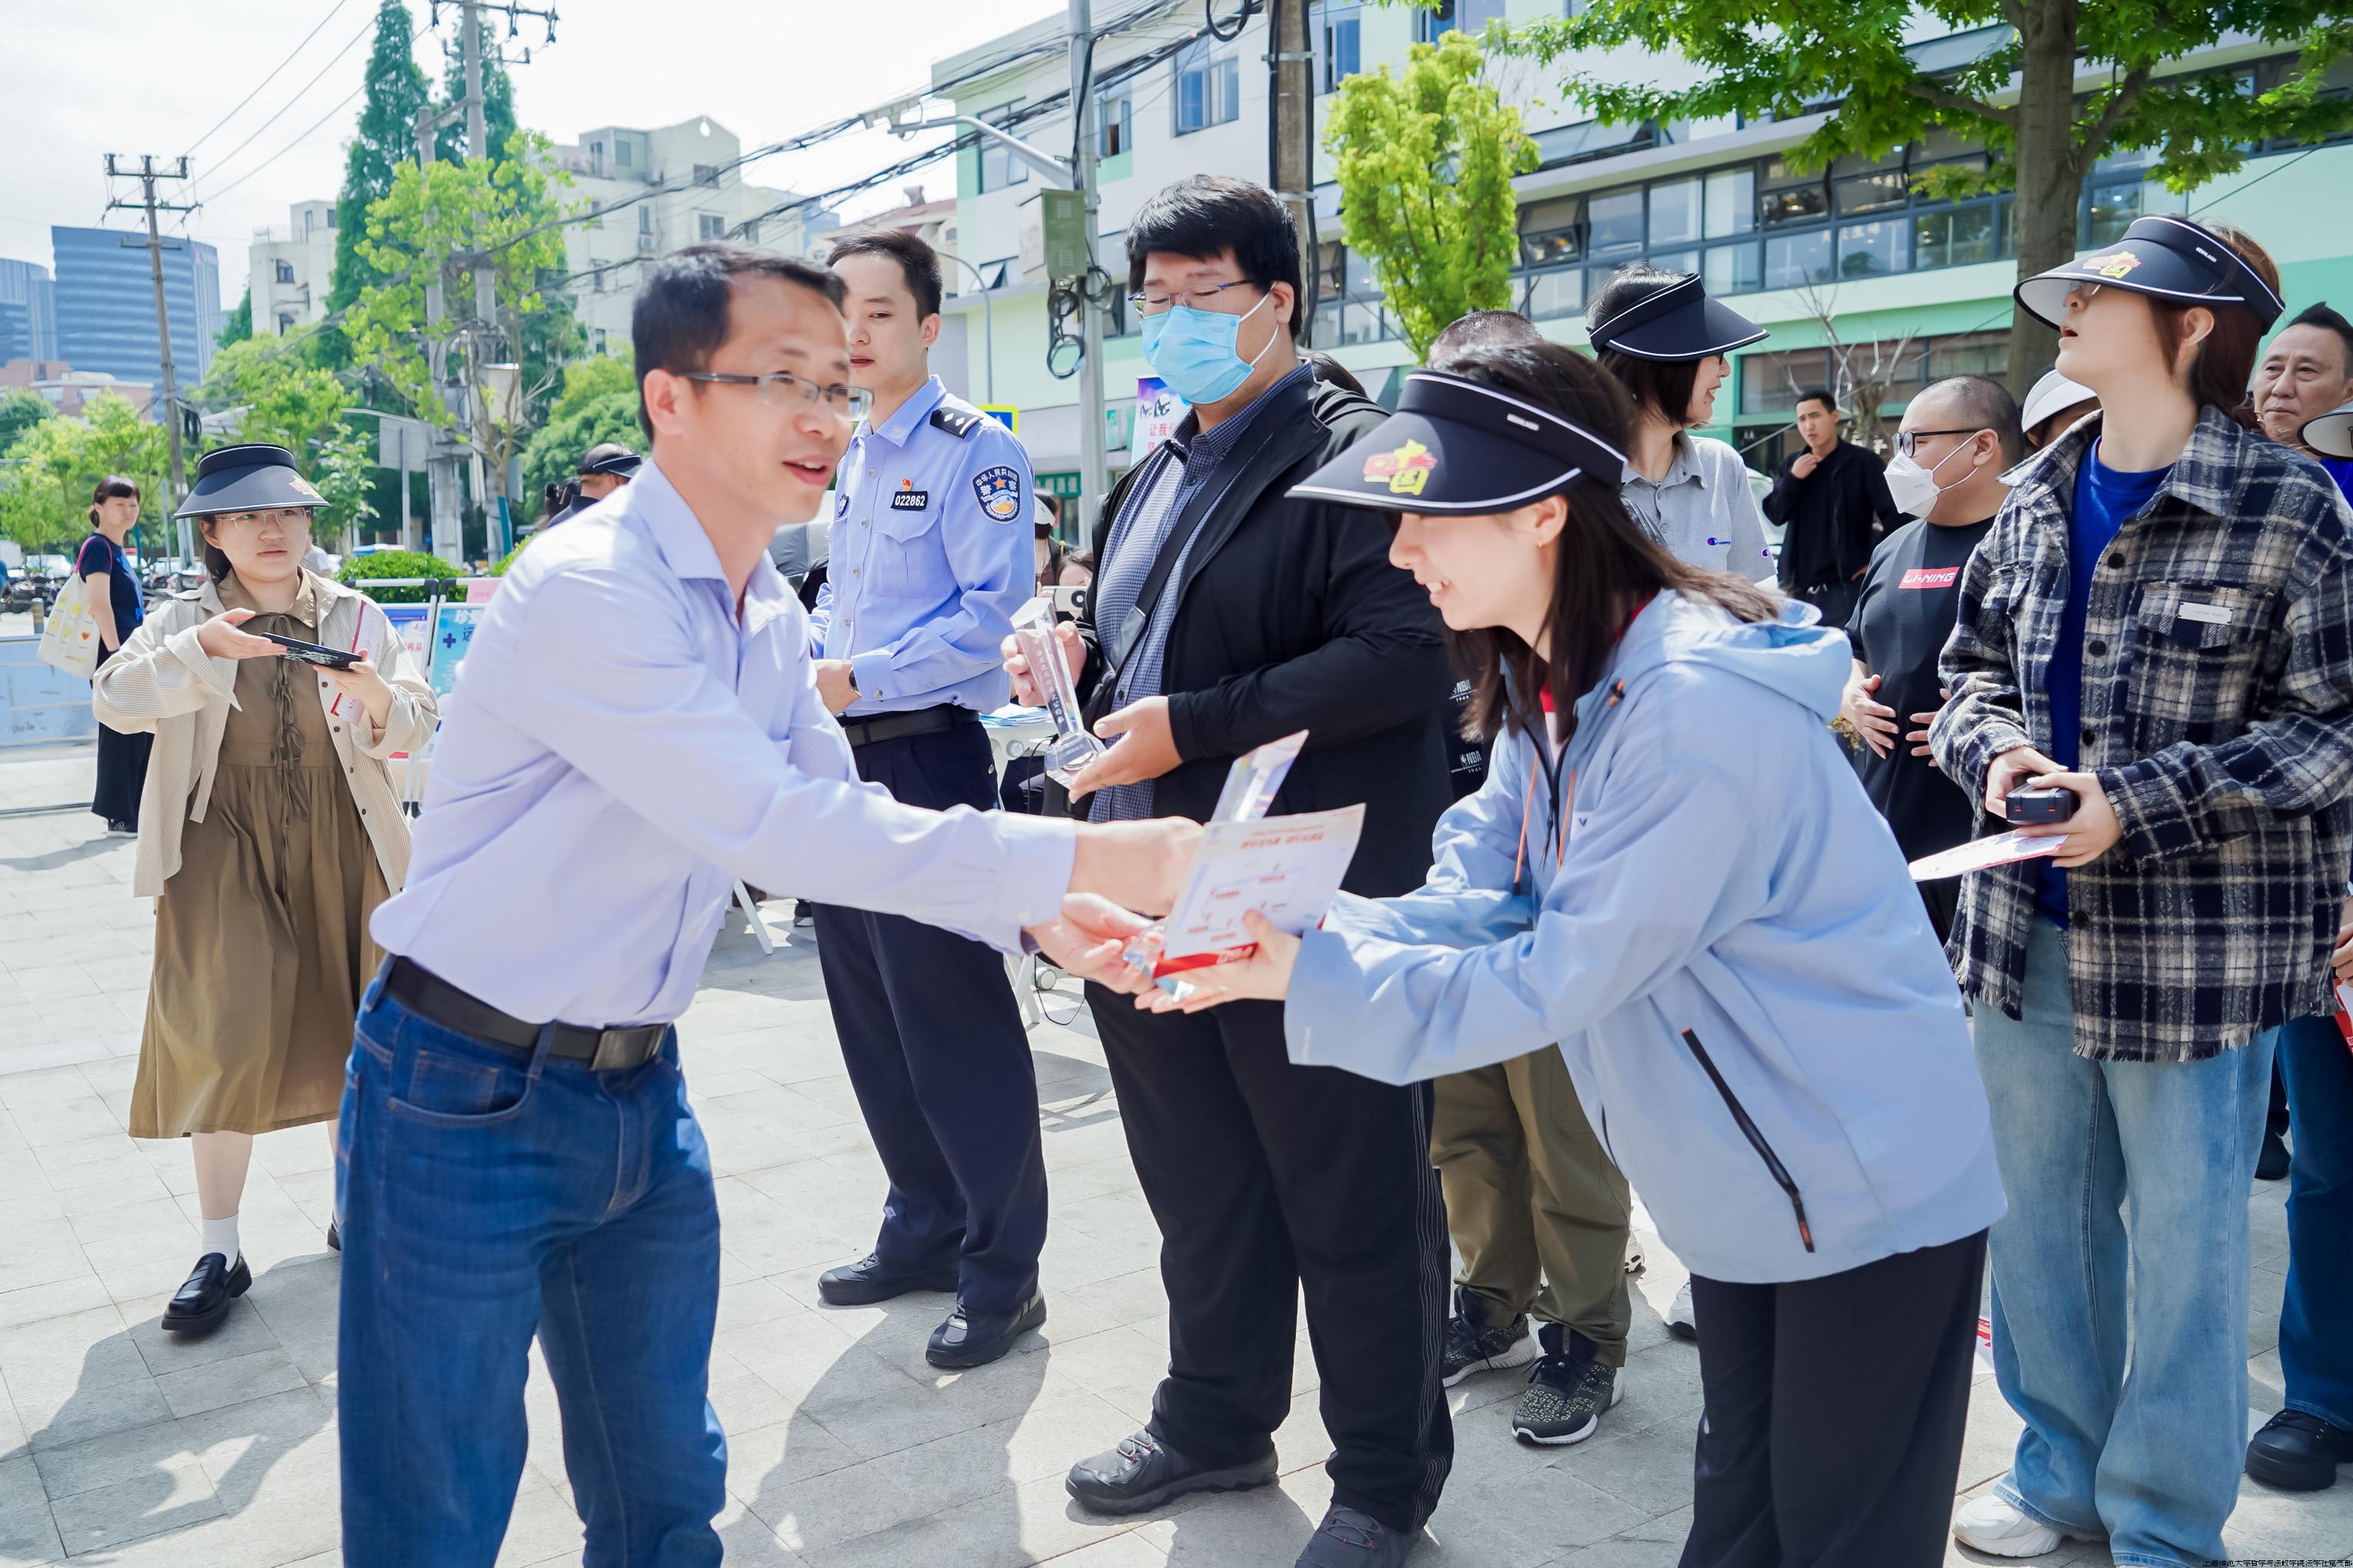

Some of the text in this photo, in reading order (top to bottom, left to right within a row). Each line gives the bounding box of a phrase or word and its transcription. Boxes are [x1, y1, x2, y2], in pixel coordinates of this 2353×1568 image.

[895, 495, 925, 507] 022862
[1903, 572, 1956, 583] LI-NING
[1456, 679, 1471, 693] NBA
[1466, 751, 1482, 765] NBA
